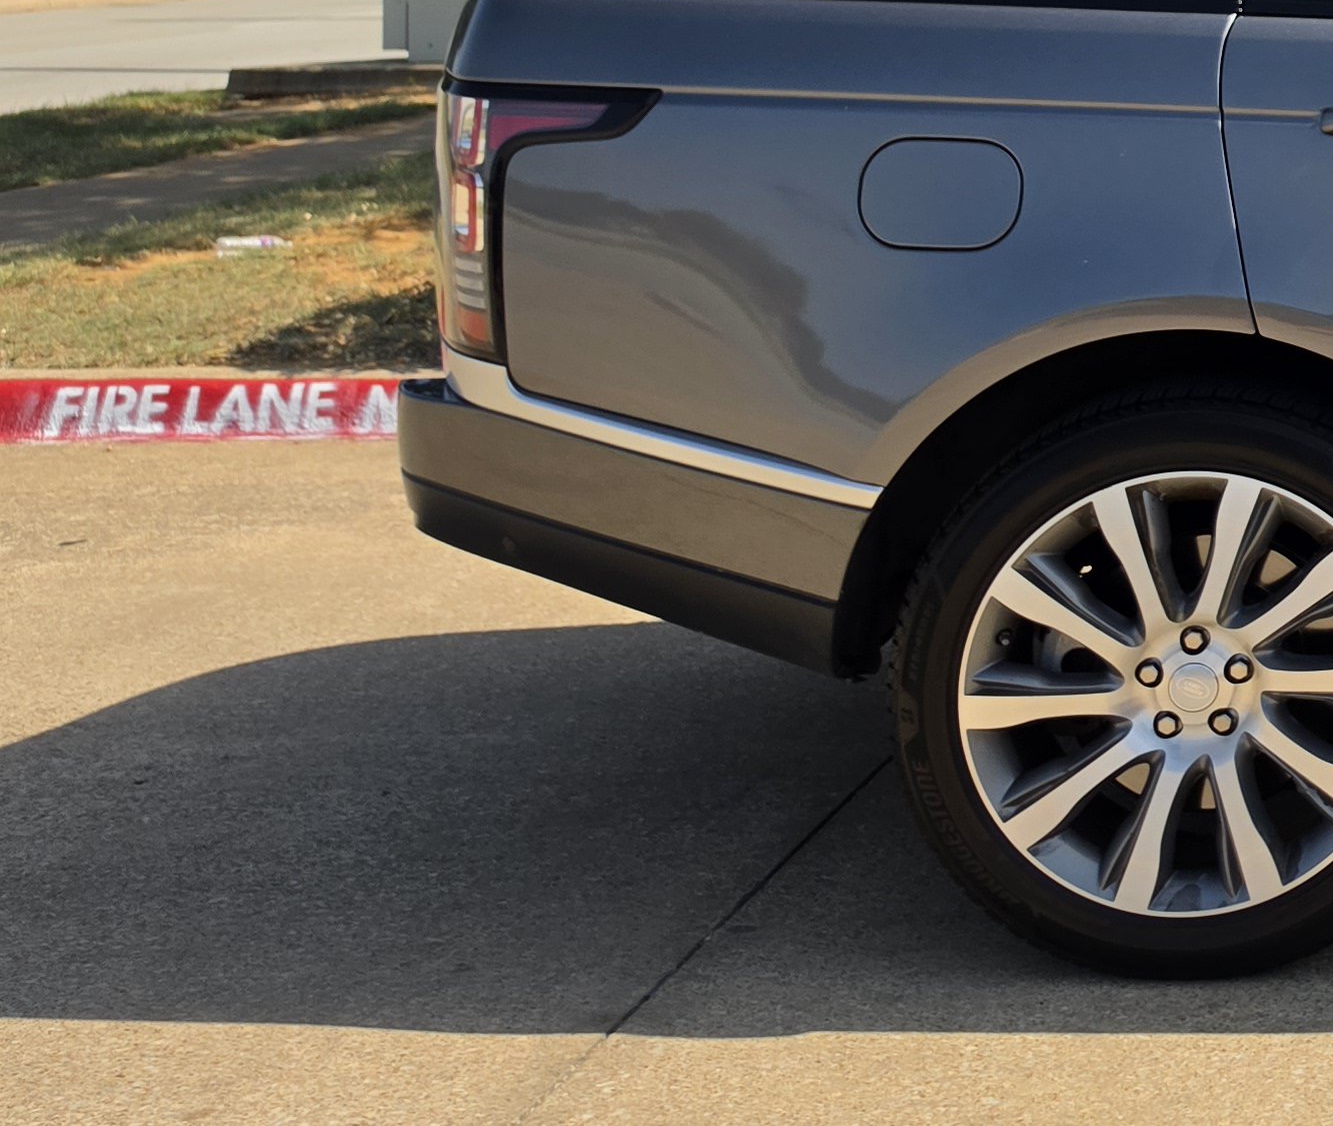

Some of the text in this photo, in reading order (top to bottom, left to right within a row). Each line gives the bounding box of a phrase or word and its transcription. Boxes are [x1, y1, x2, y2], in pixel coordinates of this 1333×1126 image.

[42, 381, 398, 438] FIRE LANE N
